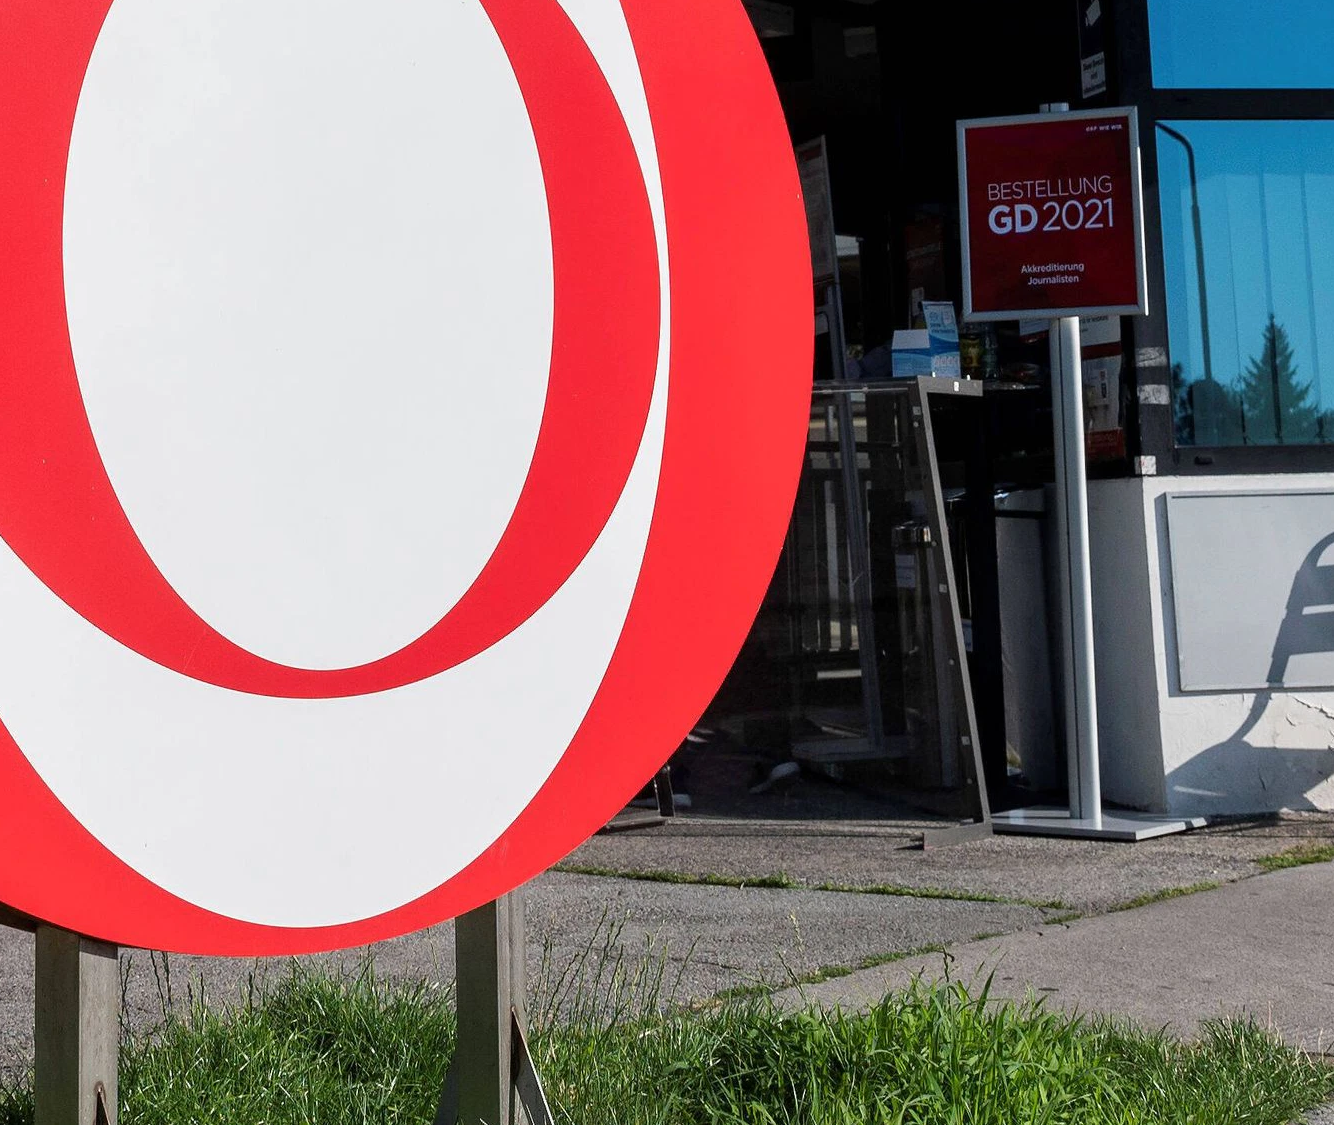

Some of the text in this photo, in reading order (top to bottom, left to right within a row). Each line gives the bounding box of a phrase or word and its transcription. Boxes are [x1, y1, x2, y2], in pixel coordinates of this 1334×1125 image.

[987, 175, 1113, 201] BESTELLUNG
[1020, 262, 1085, 274] Akkreditierung
[1027, 274, 1079, 286] Journalisten
